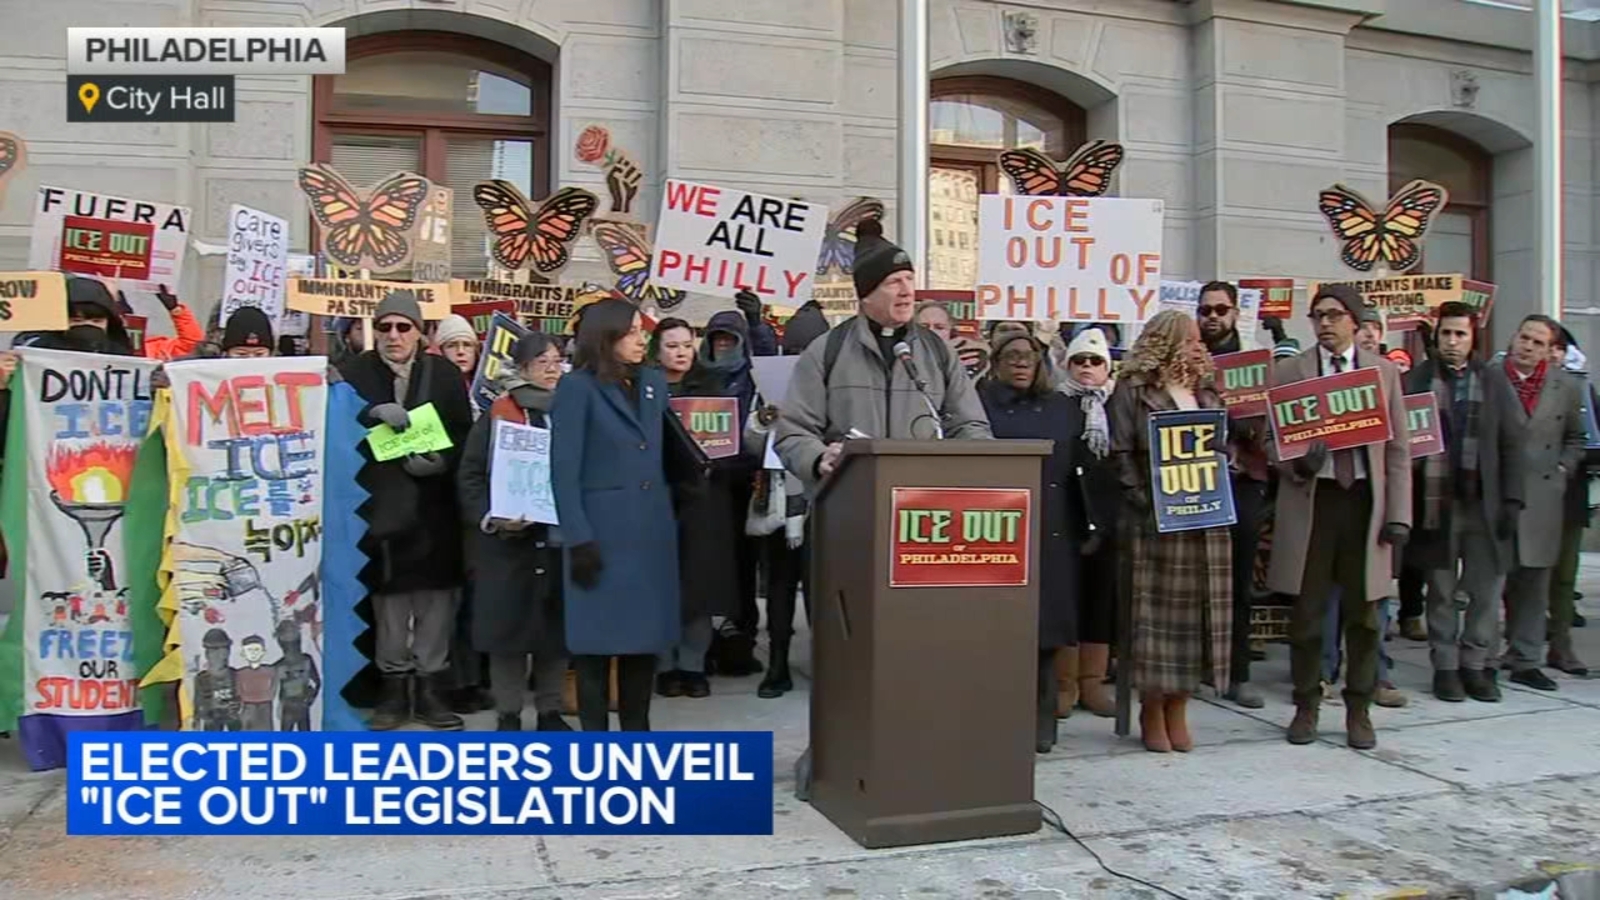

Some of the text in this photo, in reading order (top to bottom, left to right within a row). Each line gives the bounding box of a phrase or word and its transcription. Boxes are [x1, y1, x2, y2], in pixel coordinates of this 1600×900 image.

[666, 181, 809, 232] WE ARE
[1003, 199, 1089, 232] ICE
[235, 209, 281, 240] Care
[705, 221, 775, 257] ALL
[65, 228, 149, 255] ICE OUT
[657, 249, 808, 298] PHILLY
[1006, 237, 1160, 286] OUT OF
[464, 280, 562, 301] IMMIGRANTS
[1412, 276, 1453, 291] MAKE
[327, 299, 346, 314] PA
[977, 285, 1156, 320] PHILLY
[1223, 364, 1268, 390] OUT
[187, 371, 323, 447] MELT
[690, 411, 732, 433] OUT
[1274, 396, 1321, 427] ICE
[1326, 385, 1377, 415] OUT
[1158, 424, 1216, 461] ICE
[1283, 417, 1382, 443] PHILADELPHIA
[207, 430, 319, 481] ICE
[1159, 461, 1218, 495] OUT
[1166, 500, 1222, 516] PHILLY
[899, 510, 1022, 543] ICE OUT
[900, 554, 1019, 565] PHILADELPHIA
[80, 660, 119, 679] OUR
